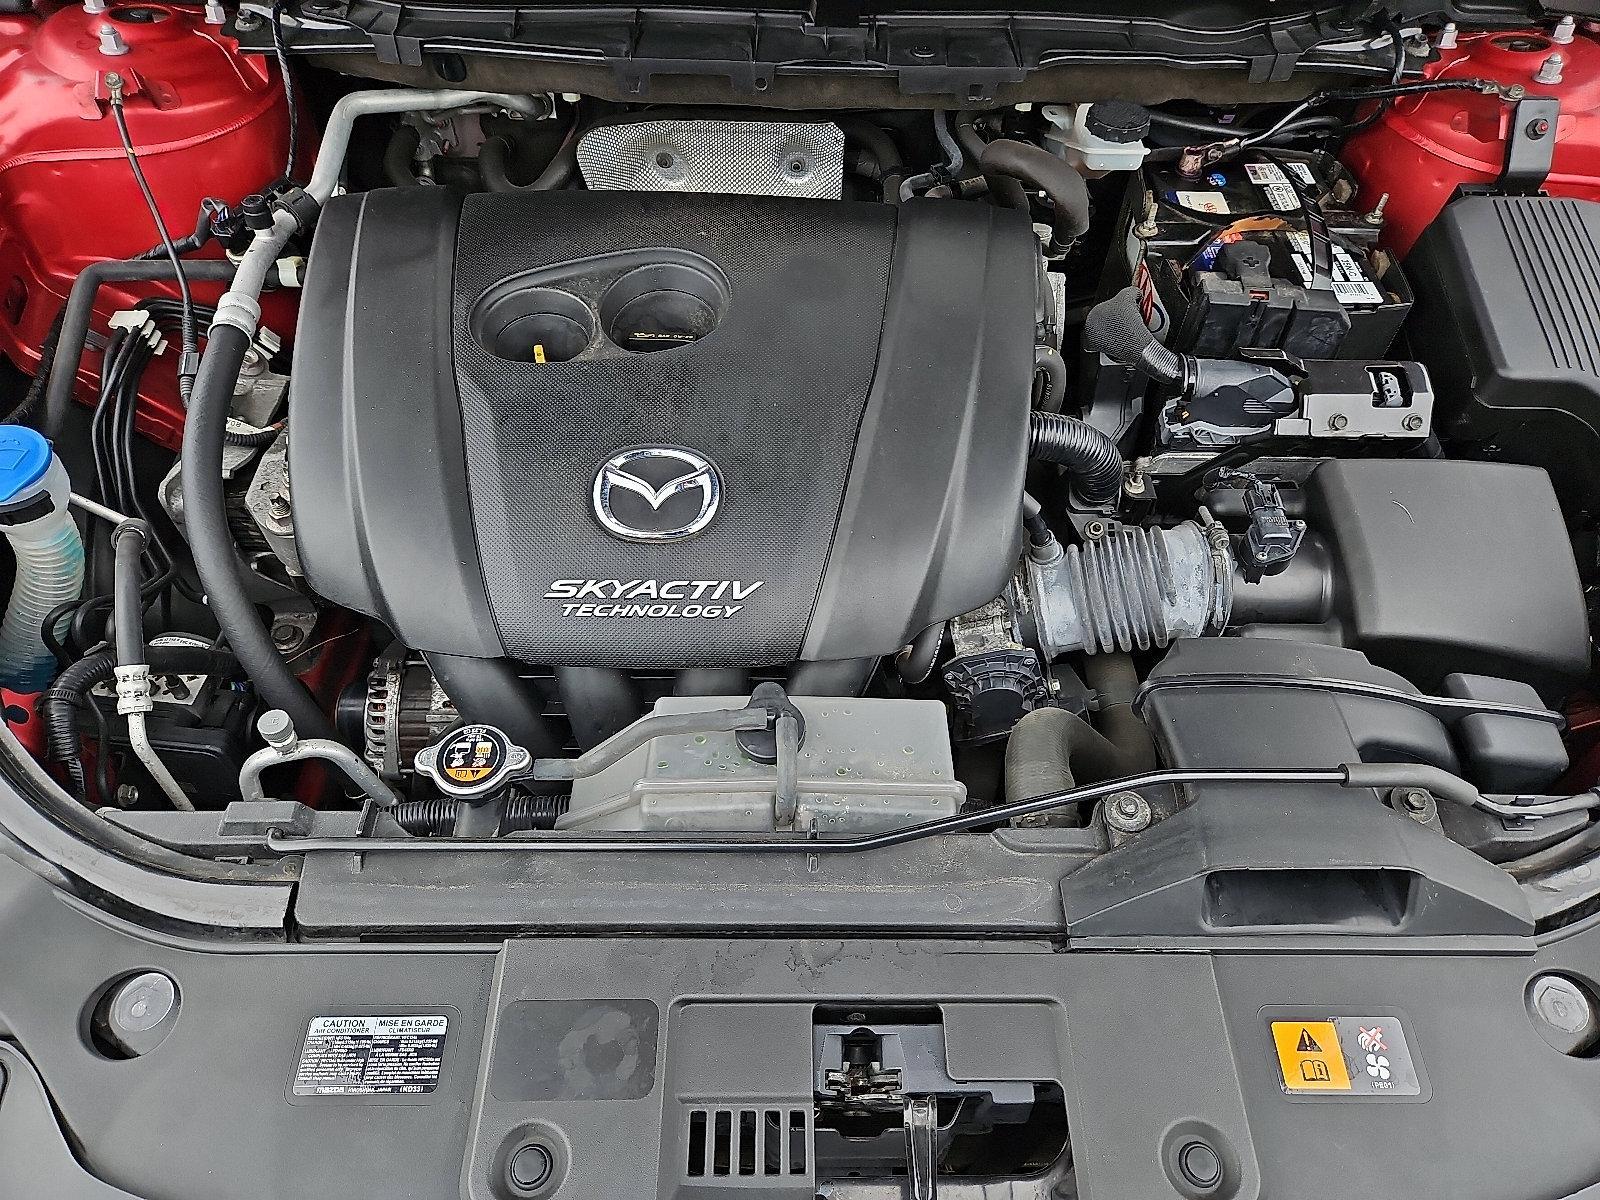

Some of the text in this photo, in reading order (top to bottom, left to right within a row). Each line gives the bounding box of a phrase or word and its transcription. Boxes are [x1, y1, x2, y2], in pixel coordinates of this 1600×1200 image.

[543, 579, 765, 600] SKYACTIV
[561, 603, 744, 619] TECHNOLOGY
[323, 1019, 366, 1028] CAUTION
[378, 1019, 444, 1027] MISE EN GARDE
